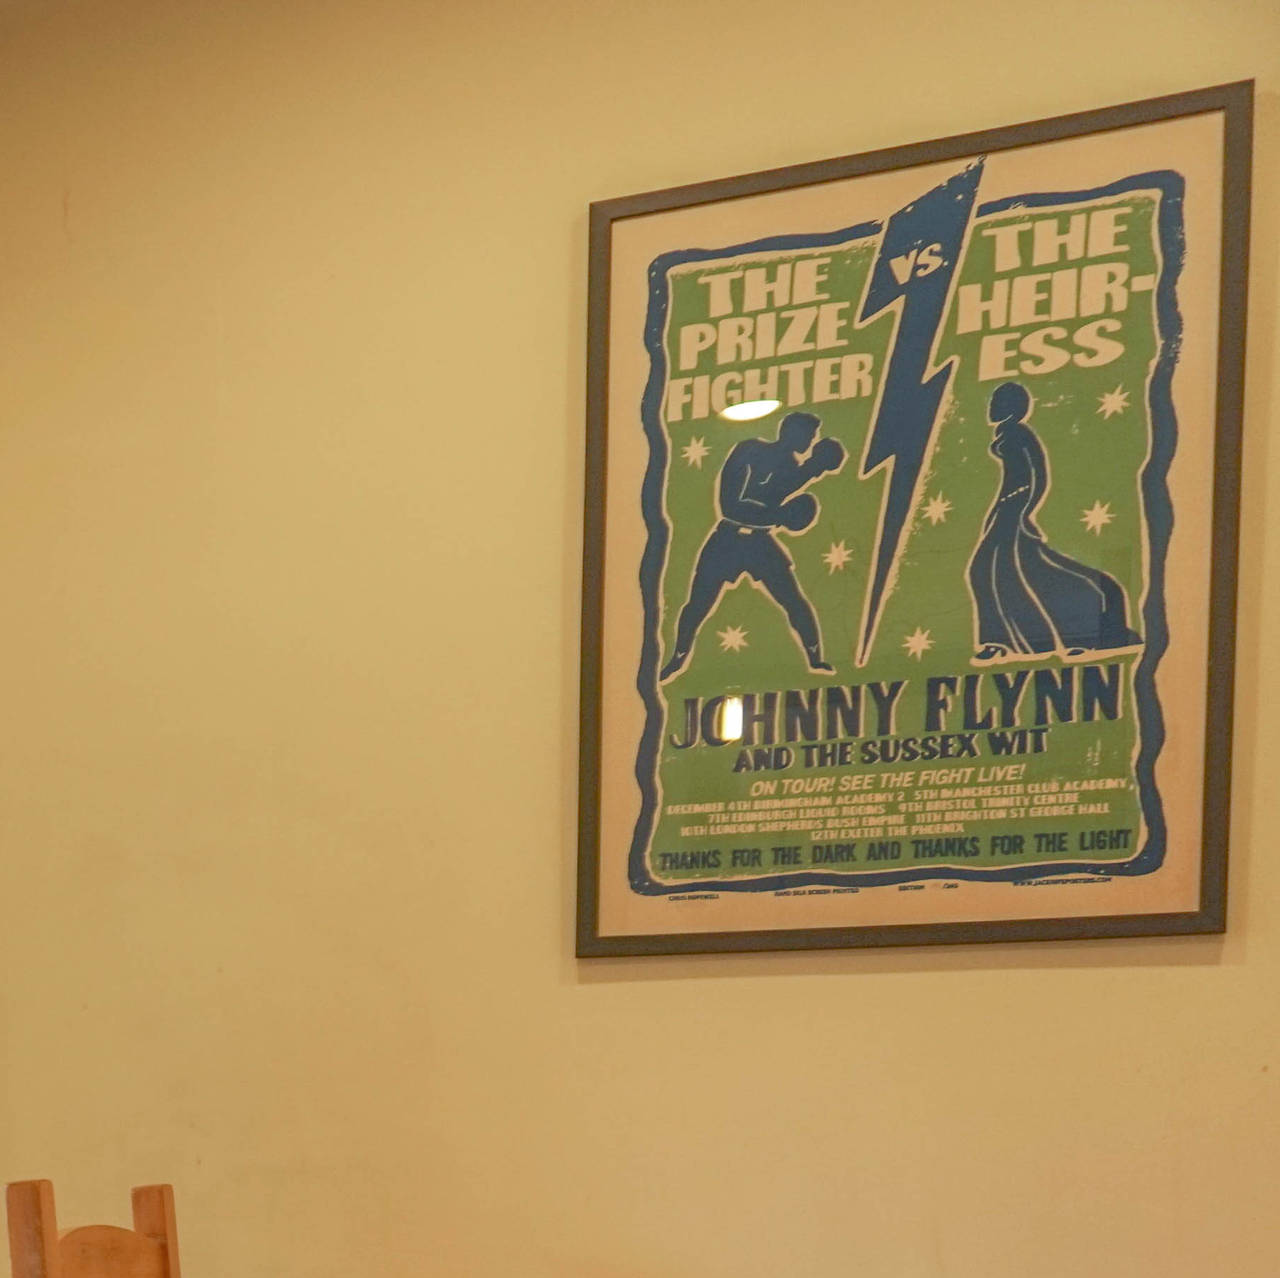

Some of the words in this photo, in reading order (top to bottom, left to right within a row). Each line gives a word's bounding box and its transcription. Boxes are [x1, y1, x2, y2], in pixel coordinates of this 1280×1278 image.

[982, 206, 1133, 273] THE
[697, 257, 832, 318] THE
[956, 262, 1156, 335] HEIR-
[679, 301, 850, 371] PRIZE
[978, 318, 1125, 382] ESS
[667, 353, 874, 422] FIGHTER
[670, 680, 909, 749] JOHNNY
[925, 663, 1124, 732] FLYNN
[733, 747, 795, 773] AND
[801, 742, 856, 768] THE
[860, 733, 981, 764] SUSSEX
[988, 728, 1052, 756] WIT
[667, 802, 726, 815] DECEMBER
[836, 793, 893, 805] ACADEMY
[896, 791, 905, 801] 2
[914, 789, 937, 800] 5TH
[940, 784, 1024, 799] MANCHESTER
[1028, 781, 1059, 794] CLUB
[750, 780, 777, 797] ON
[782, 777, 836, 794] TOUR!
[839, 774, 877, 791] SEE
[880, 771, 915, 787] THE
[918, 767, 976, 786] FIGHT
[977, 764, 1026, 783] LIVE!
[710, 822, 756, 835] LONDON
[826, 817, 860, 829] BUSH
[862, 814, 906, 827] EMPIRE
[944, 808, 1006, 823] BRIGHTON
[1008, 807, 1026, 819] ST
[1029, 804, 1075, 818] GEORGE
[1077, 802, 1111, 815] HALL
[732, 809, 797, 823] EDINBURGH
[898, 801, 923, 813] 9TH
[926, 798, 977, 811] BRISTOL
[1033, 792, 1080, 806] CENTRE
[811, 829, 838, 841] 12TH
[841, 827, 884, 840] EXETER
[887, 825, 907, 837] THE
[911, 822, 964, 836] PHOENIX
[659, 848, 722, 871] THANKS
[731, 848, 762, 868] FOR
[771, 845, 803, 866] THE
[812, 842, 857, 864] DARK
[867, 841, 901, 861] AND
[911, 836, 980, 859] THANKS
[991, 834, 1024, 856] FOR
[1033, 832, 1069, 854] THE
[1079, 829, 1132, 852] LIGHT
